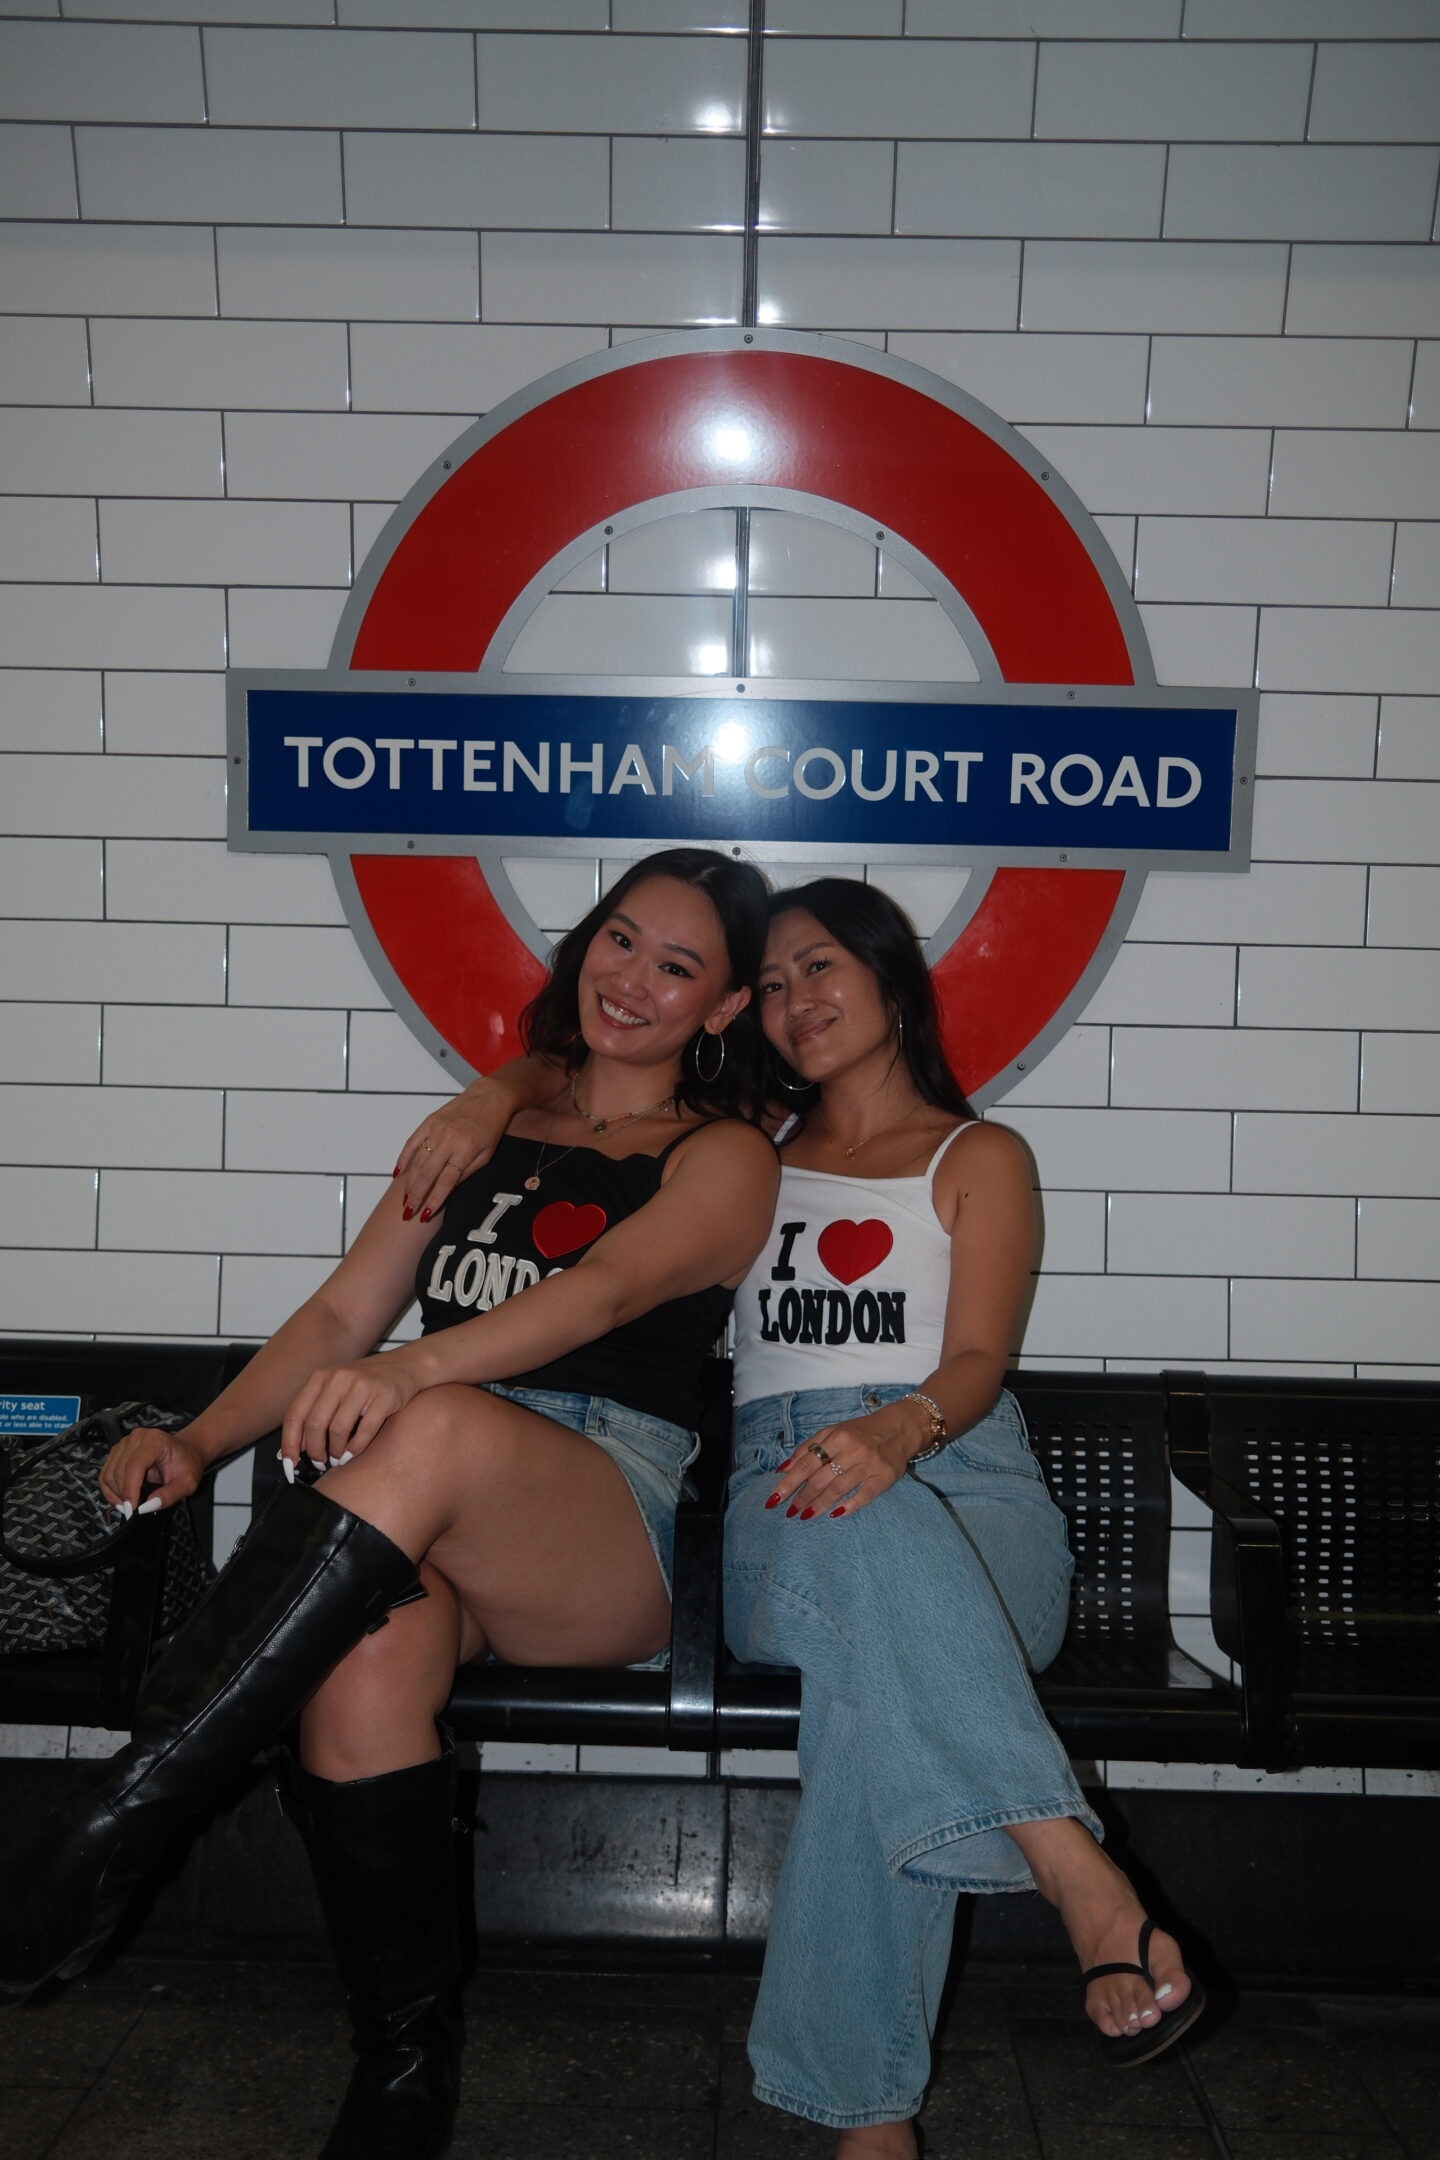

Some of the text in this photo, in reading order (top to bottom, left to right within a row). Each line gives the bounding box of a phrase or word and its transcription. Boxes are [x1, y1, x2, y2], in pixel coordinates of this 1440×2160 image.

[284, 736, 1202, 808] TOTTENHAM COURT ROAD
[467, 1192, 523, 1244] I
[427, 1245, 565, 1311] LOND
[771, 1222, 806, 1281] I
[758, 1287, 906, 1345] LONDON
[21, 1401, 46, 1411] seat
